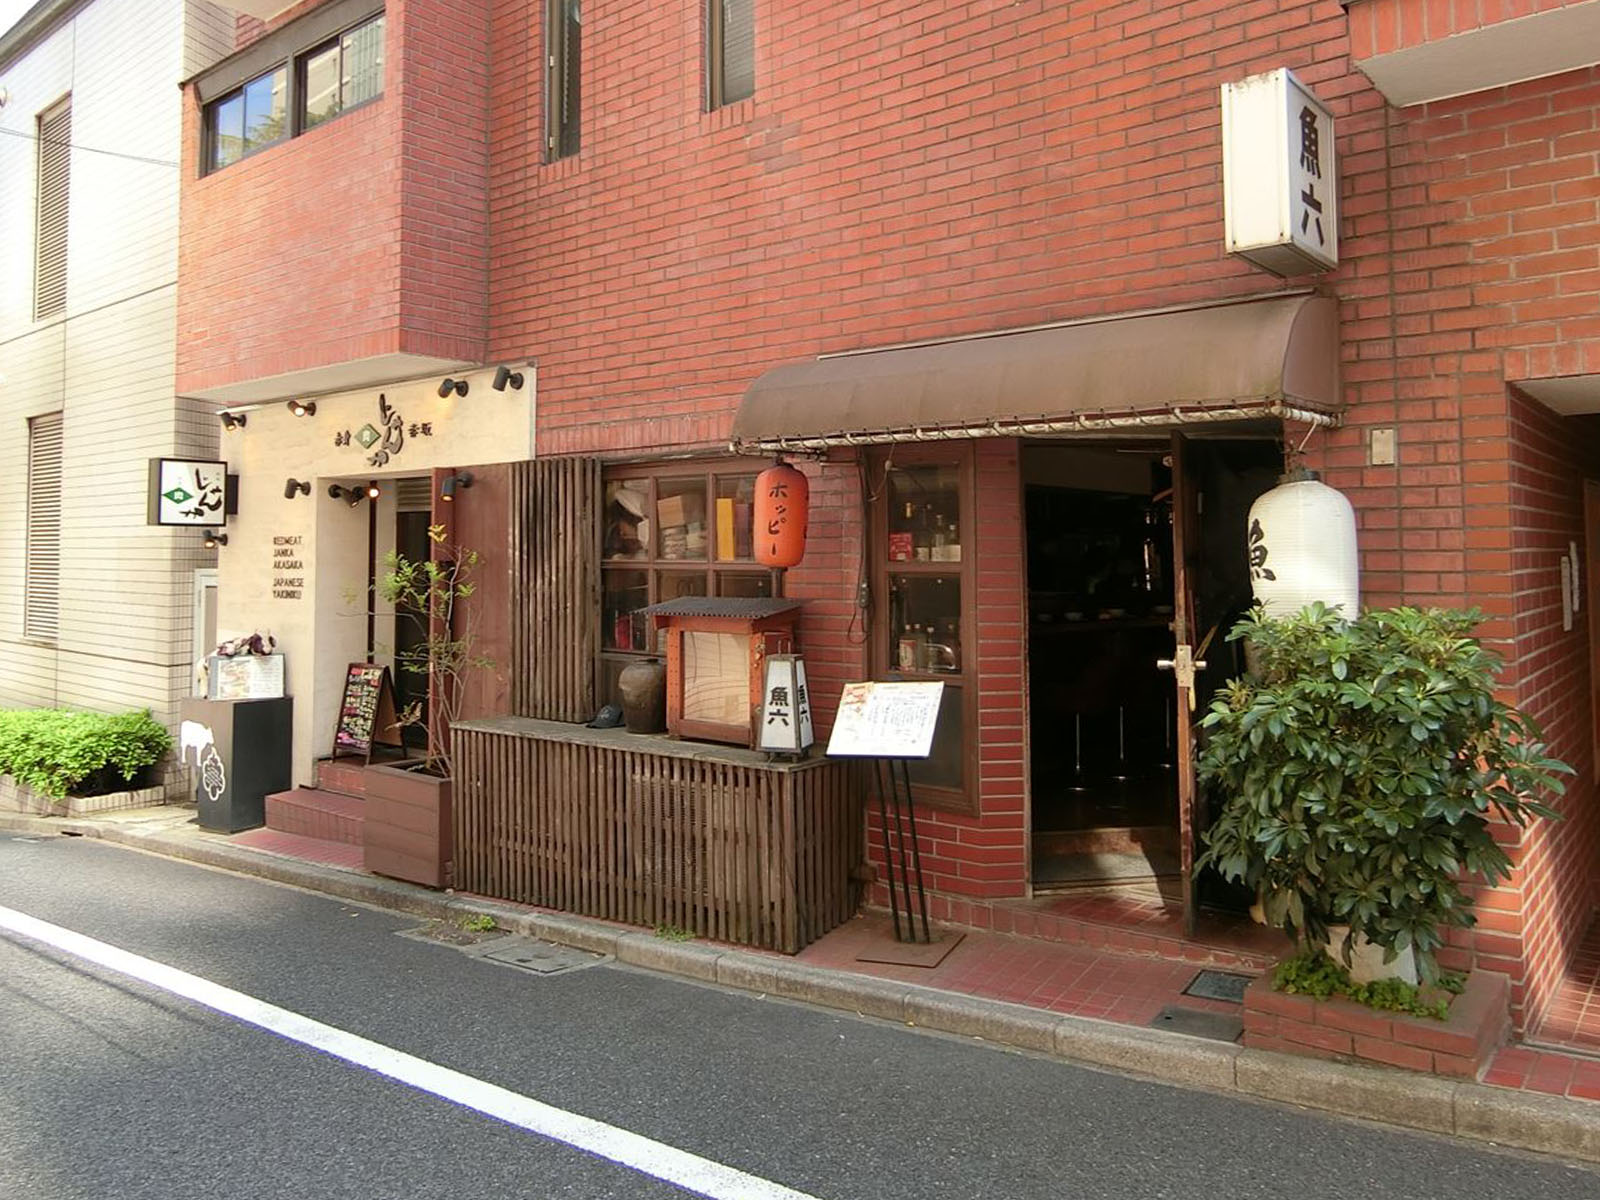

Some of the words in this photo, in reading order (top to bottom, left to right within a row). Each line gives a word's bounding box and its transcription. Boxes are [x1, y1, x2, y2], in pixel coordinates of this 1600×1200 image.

[1300, 105, 1324, 247] 魚六
[769, 482, 788, 555] ホッピー
[272, 561, 304, 569] AKASAKA
[273, 578, 304, 587] JAPANESE
[768, 686, 789, 726] 魚六
